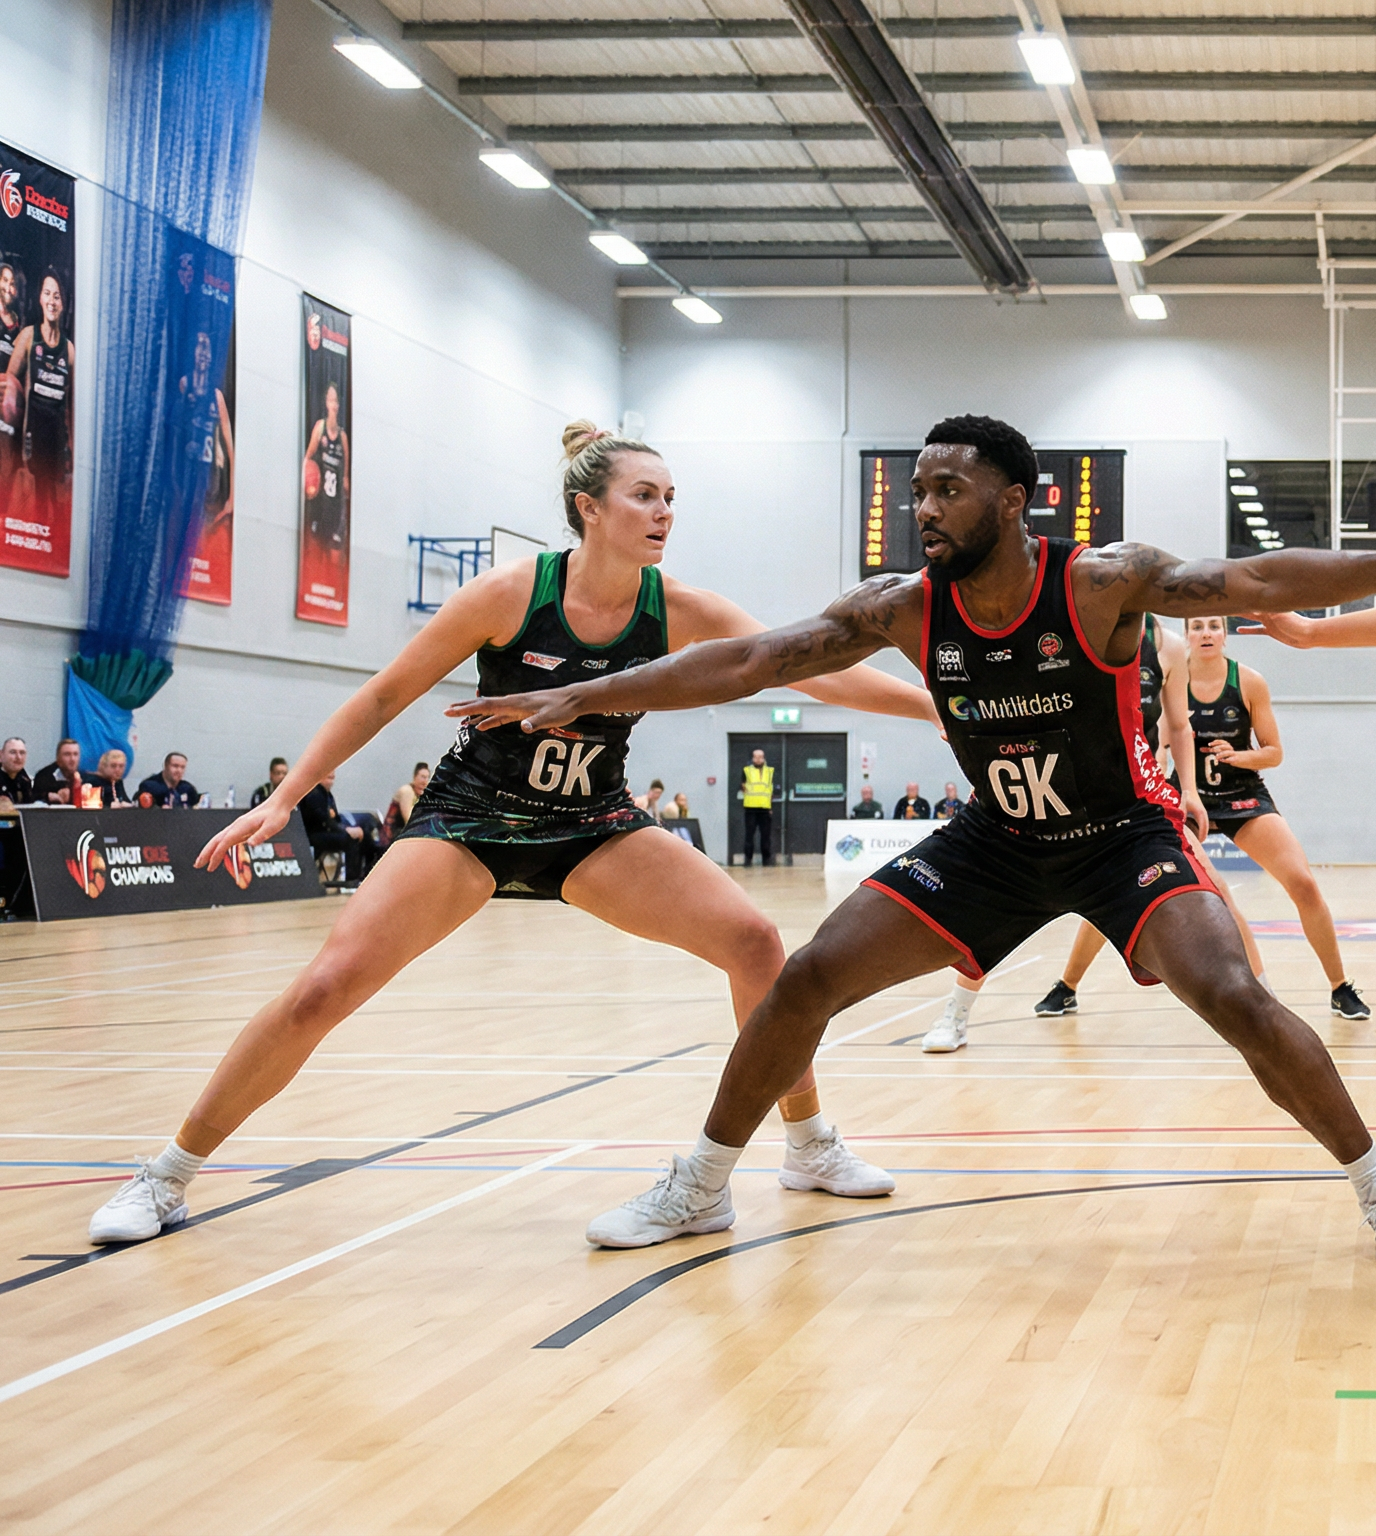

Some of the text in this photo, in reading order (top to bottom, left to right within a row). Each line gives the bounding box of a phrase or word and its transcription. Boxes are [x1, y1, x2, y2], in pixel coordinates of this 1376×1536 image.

[529, 739, 606, 796] GK
[988, 753, 1072, 820] GK
[1204, 754, 1222, 786] C
